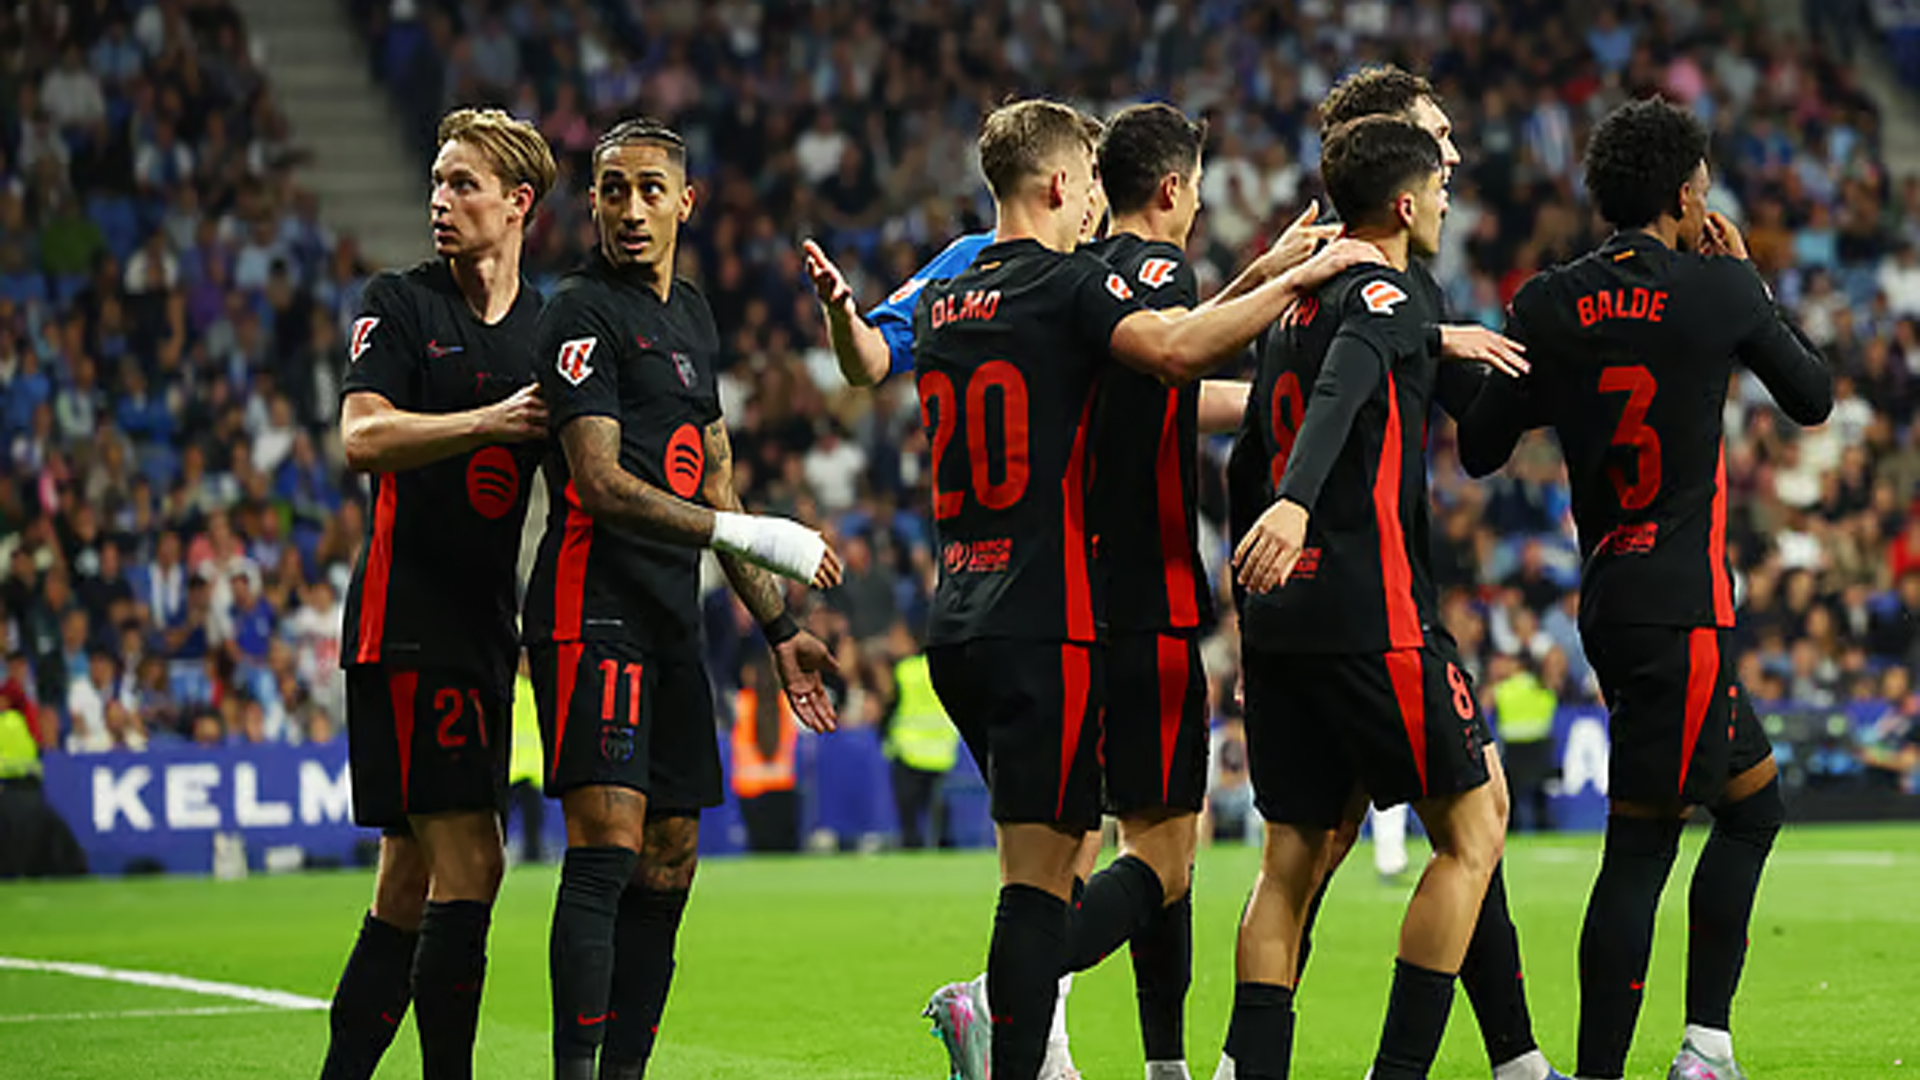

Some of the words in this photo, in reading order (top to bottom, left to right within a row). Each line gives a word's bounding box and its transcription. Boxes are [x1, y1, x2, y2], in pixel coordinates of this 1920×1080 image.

[931, 290, 1000, 329] OLMO
[1577, 288, 1668, 328] BALDE
[918, 359, 1030, 521] 20
[1598, 364, 1663, 511] 3
[433, 687, 489, 748] 21
[598, 658, 643, 726] 11
[1446, 661, 1476, 721] 8
